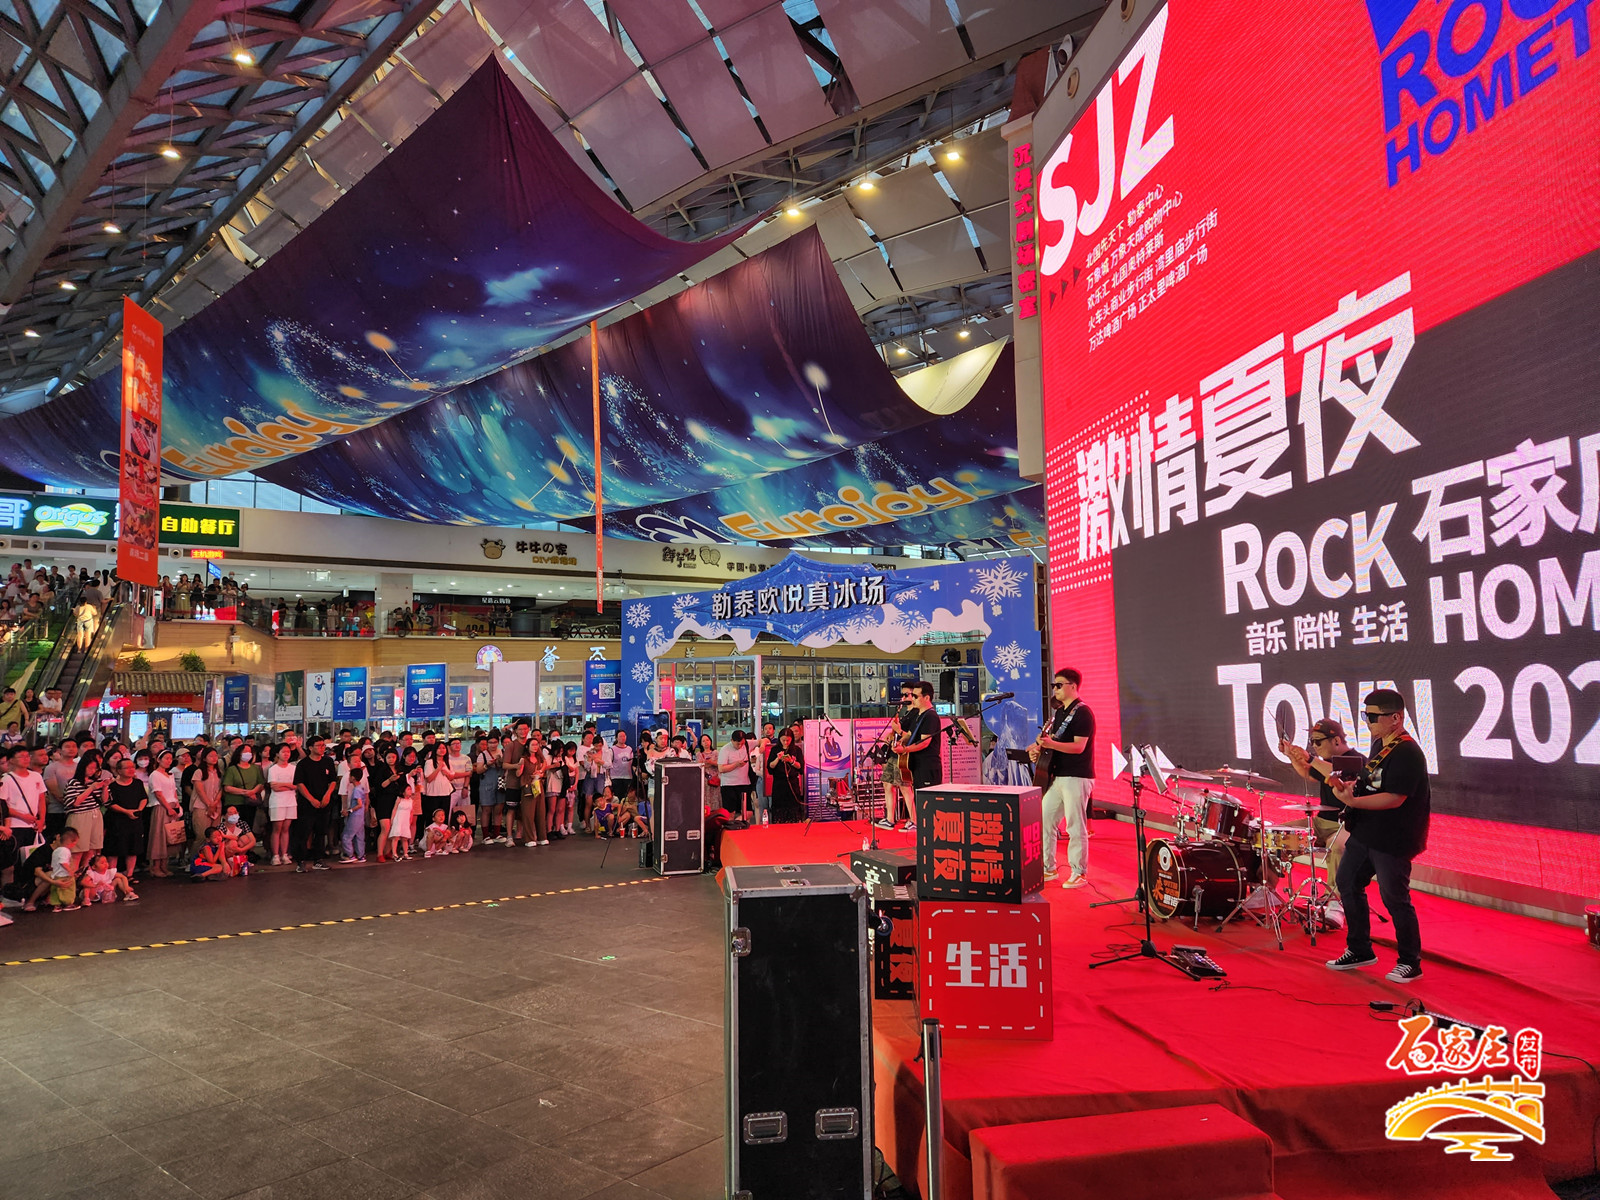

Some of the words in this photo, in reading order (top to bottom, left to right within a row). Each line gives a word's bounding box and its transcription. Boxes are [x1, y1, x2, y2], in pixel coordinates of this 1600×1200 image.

[1381, 0, 1560, 134] RO
[1039, 1, 1174, 276] SJZ
[1086, 219, 1125, 269] 北国先天下
[1127, 183, 1164, 228] 勒泰中心
[1086, 257, 1110, 291] 万象城
[1111, 191, 1183, 269] 万象天成购物中心
[1087, 279, 1110, 311] 欢乐汇
[1111, 228, 1164, 288] 北国奥特莱斯
[1088, 263, 1154, 333] 火车头商业步行街
[1155, 208, 1218, 275] 湾里庙步行街
[1089, 302, 1137, 353] 万达啤酒广场
[1138, 243, 1208, 314] 正太里啤酒广场
[1076, 271, 1421, 561] 激情夏夜
[161, 516, 236, 536] 自助餐厅
[516, 540, 568, 556] 牛牛の家
[719, 477, 980, 540] Eurojoy
[711, 575, 887, 621] 勒泰欧悦真冰场
[1221, 502, 1408, 615] ROCK
[1245, 618, 1288, 656] 音乐
[1293, 610, 1342, 652] 陪伴
[1351, 600, 1409, 645] 生活
[933, 809, 966, 882] 夏夜
[969, 811, 1004, 885] 激情
[945, 941, 1028, 988] 生活
